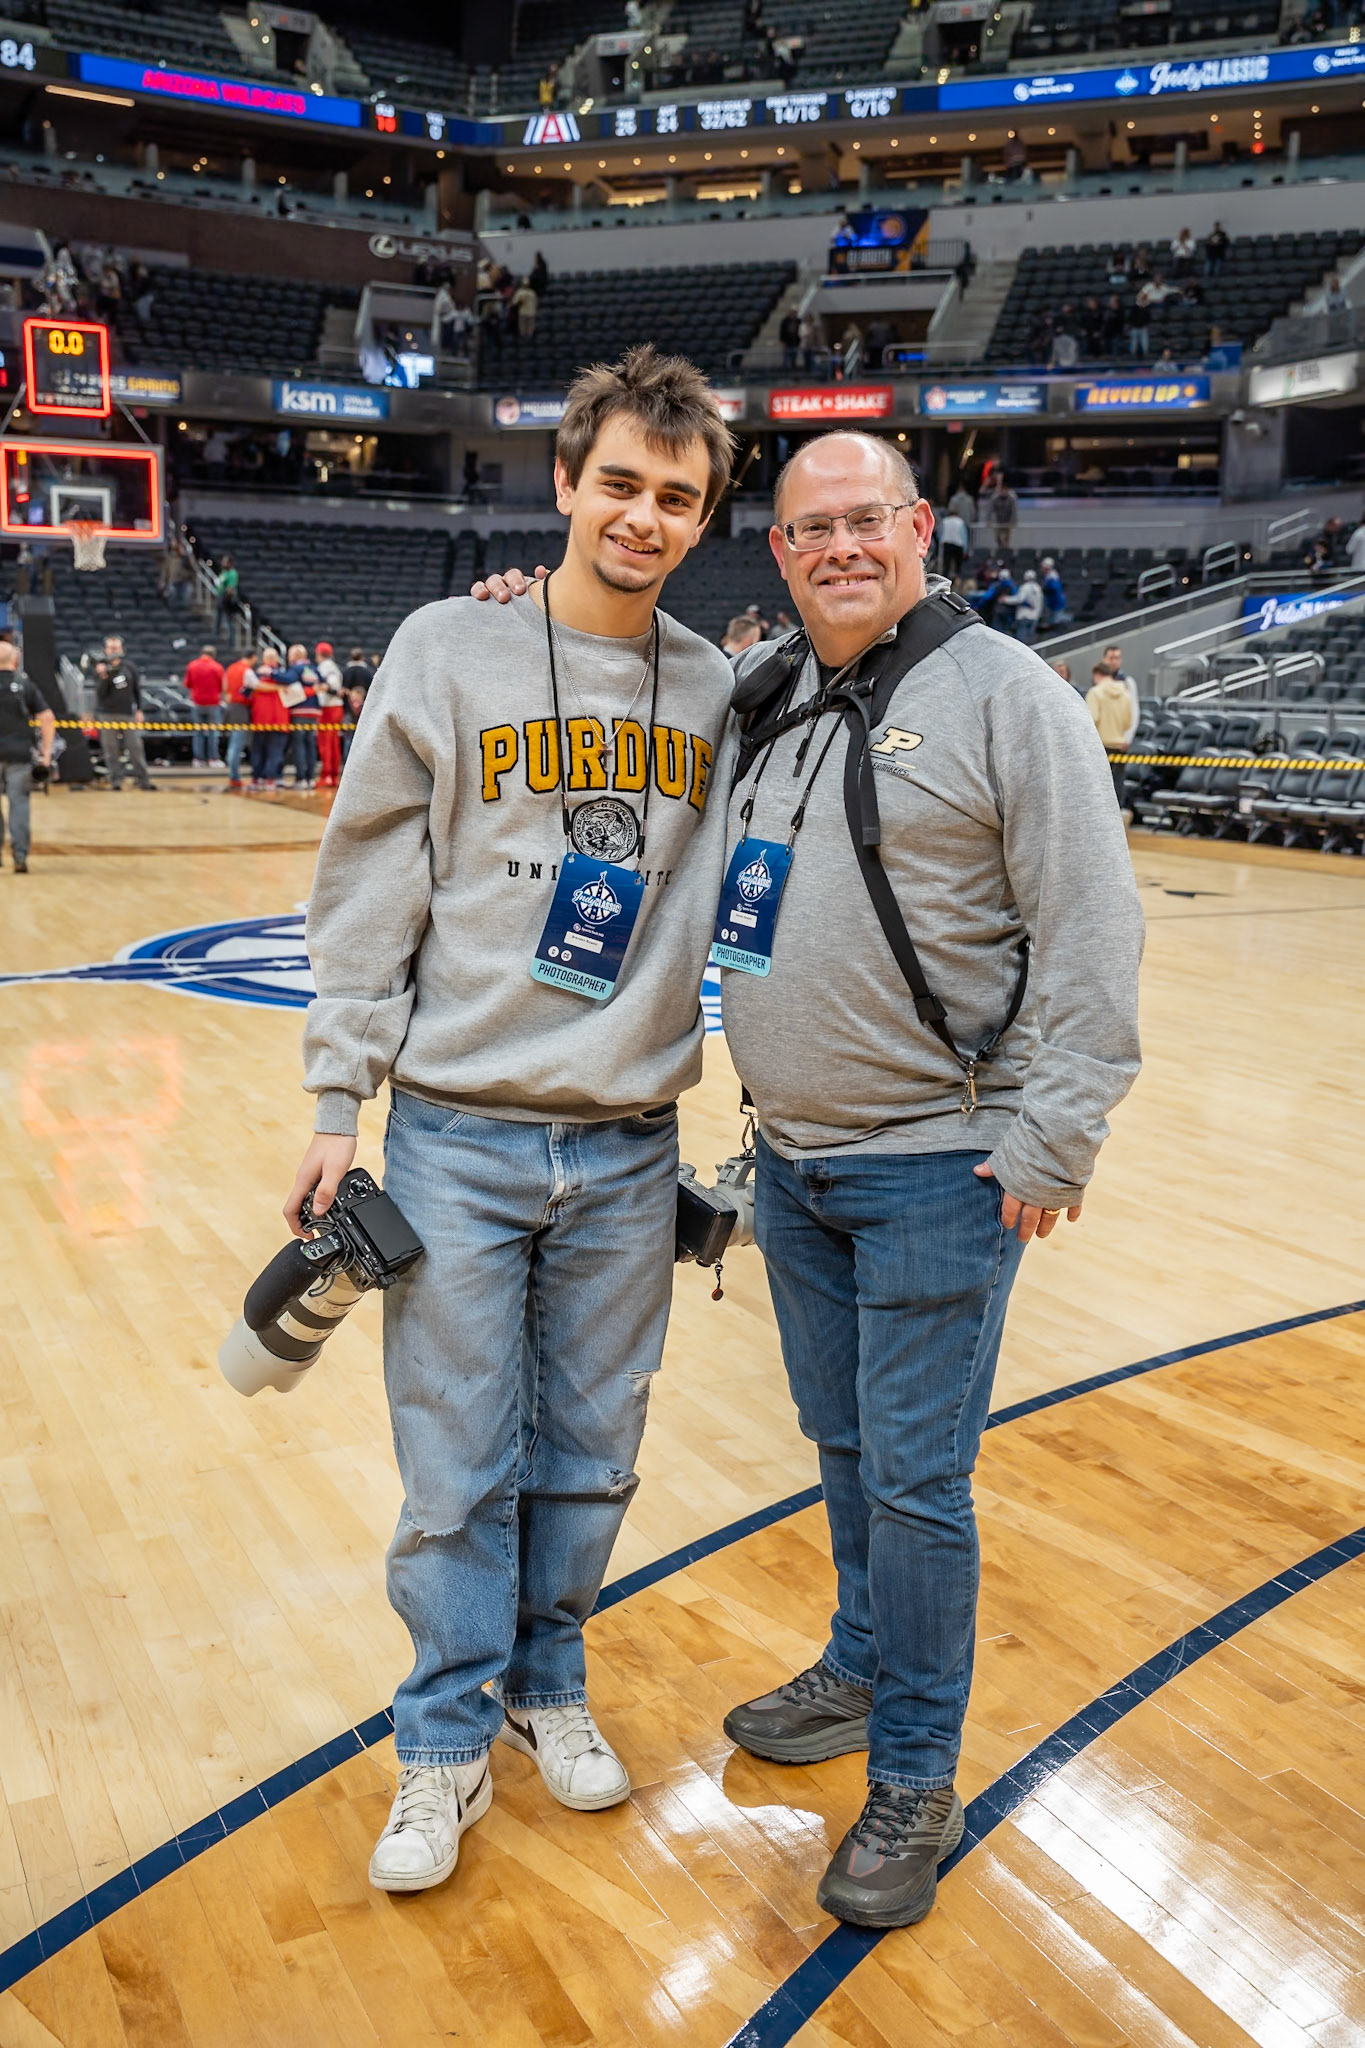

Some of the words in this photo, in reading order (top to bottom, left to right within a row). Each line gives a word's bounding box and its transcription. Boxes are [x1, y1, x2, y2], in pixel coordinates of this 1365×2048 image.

[0, 39, 36, 71] 84
[142, 69, 220, 99] ARIZONA
[221, 83, 306, 115] WILDCATS
[49, 330, 84, 355] 0.0
[282, 382, 336, 413] ksm
[772, 395, 822, 413] STEAK
[834, 392, 888, 410] SHAKE
[1087, 386, 1153, 404] REVVED
[1155, 385, 1179, 403] UP
[870, 726, 924, 756] P
[480, 716, 713, 813] PURDUE
[873, 761, 908, 777] ERMAKERS
[507, 860, 672, 887] UNIITY
[717, 947, 766, 970] PHOTOGRAPHER
[538, 963, 607, 994] PHOTOGRAPHER
